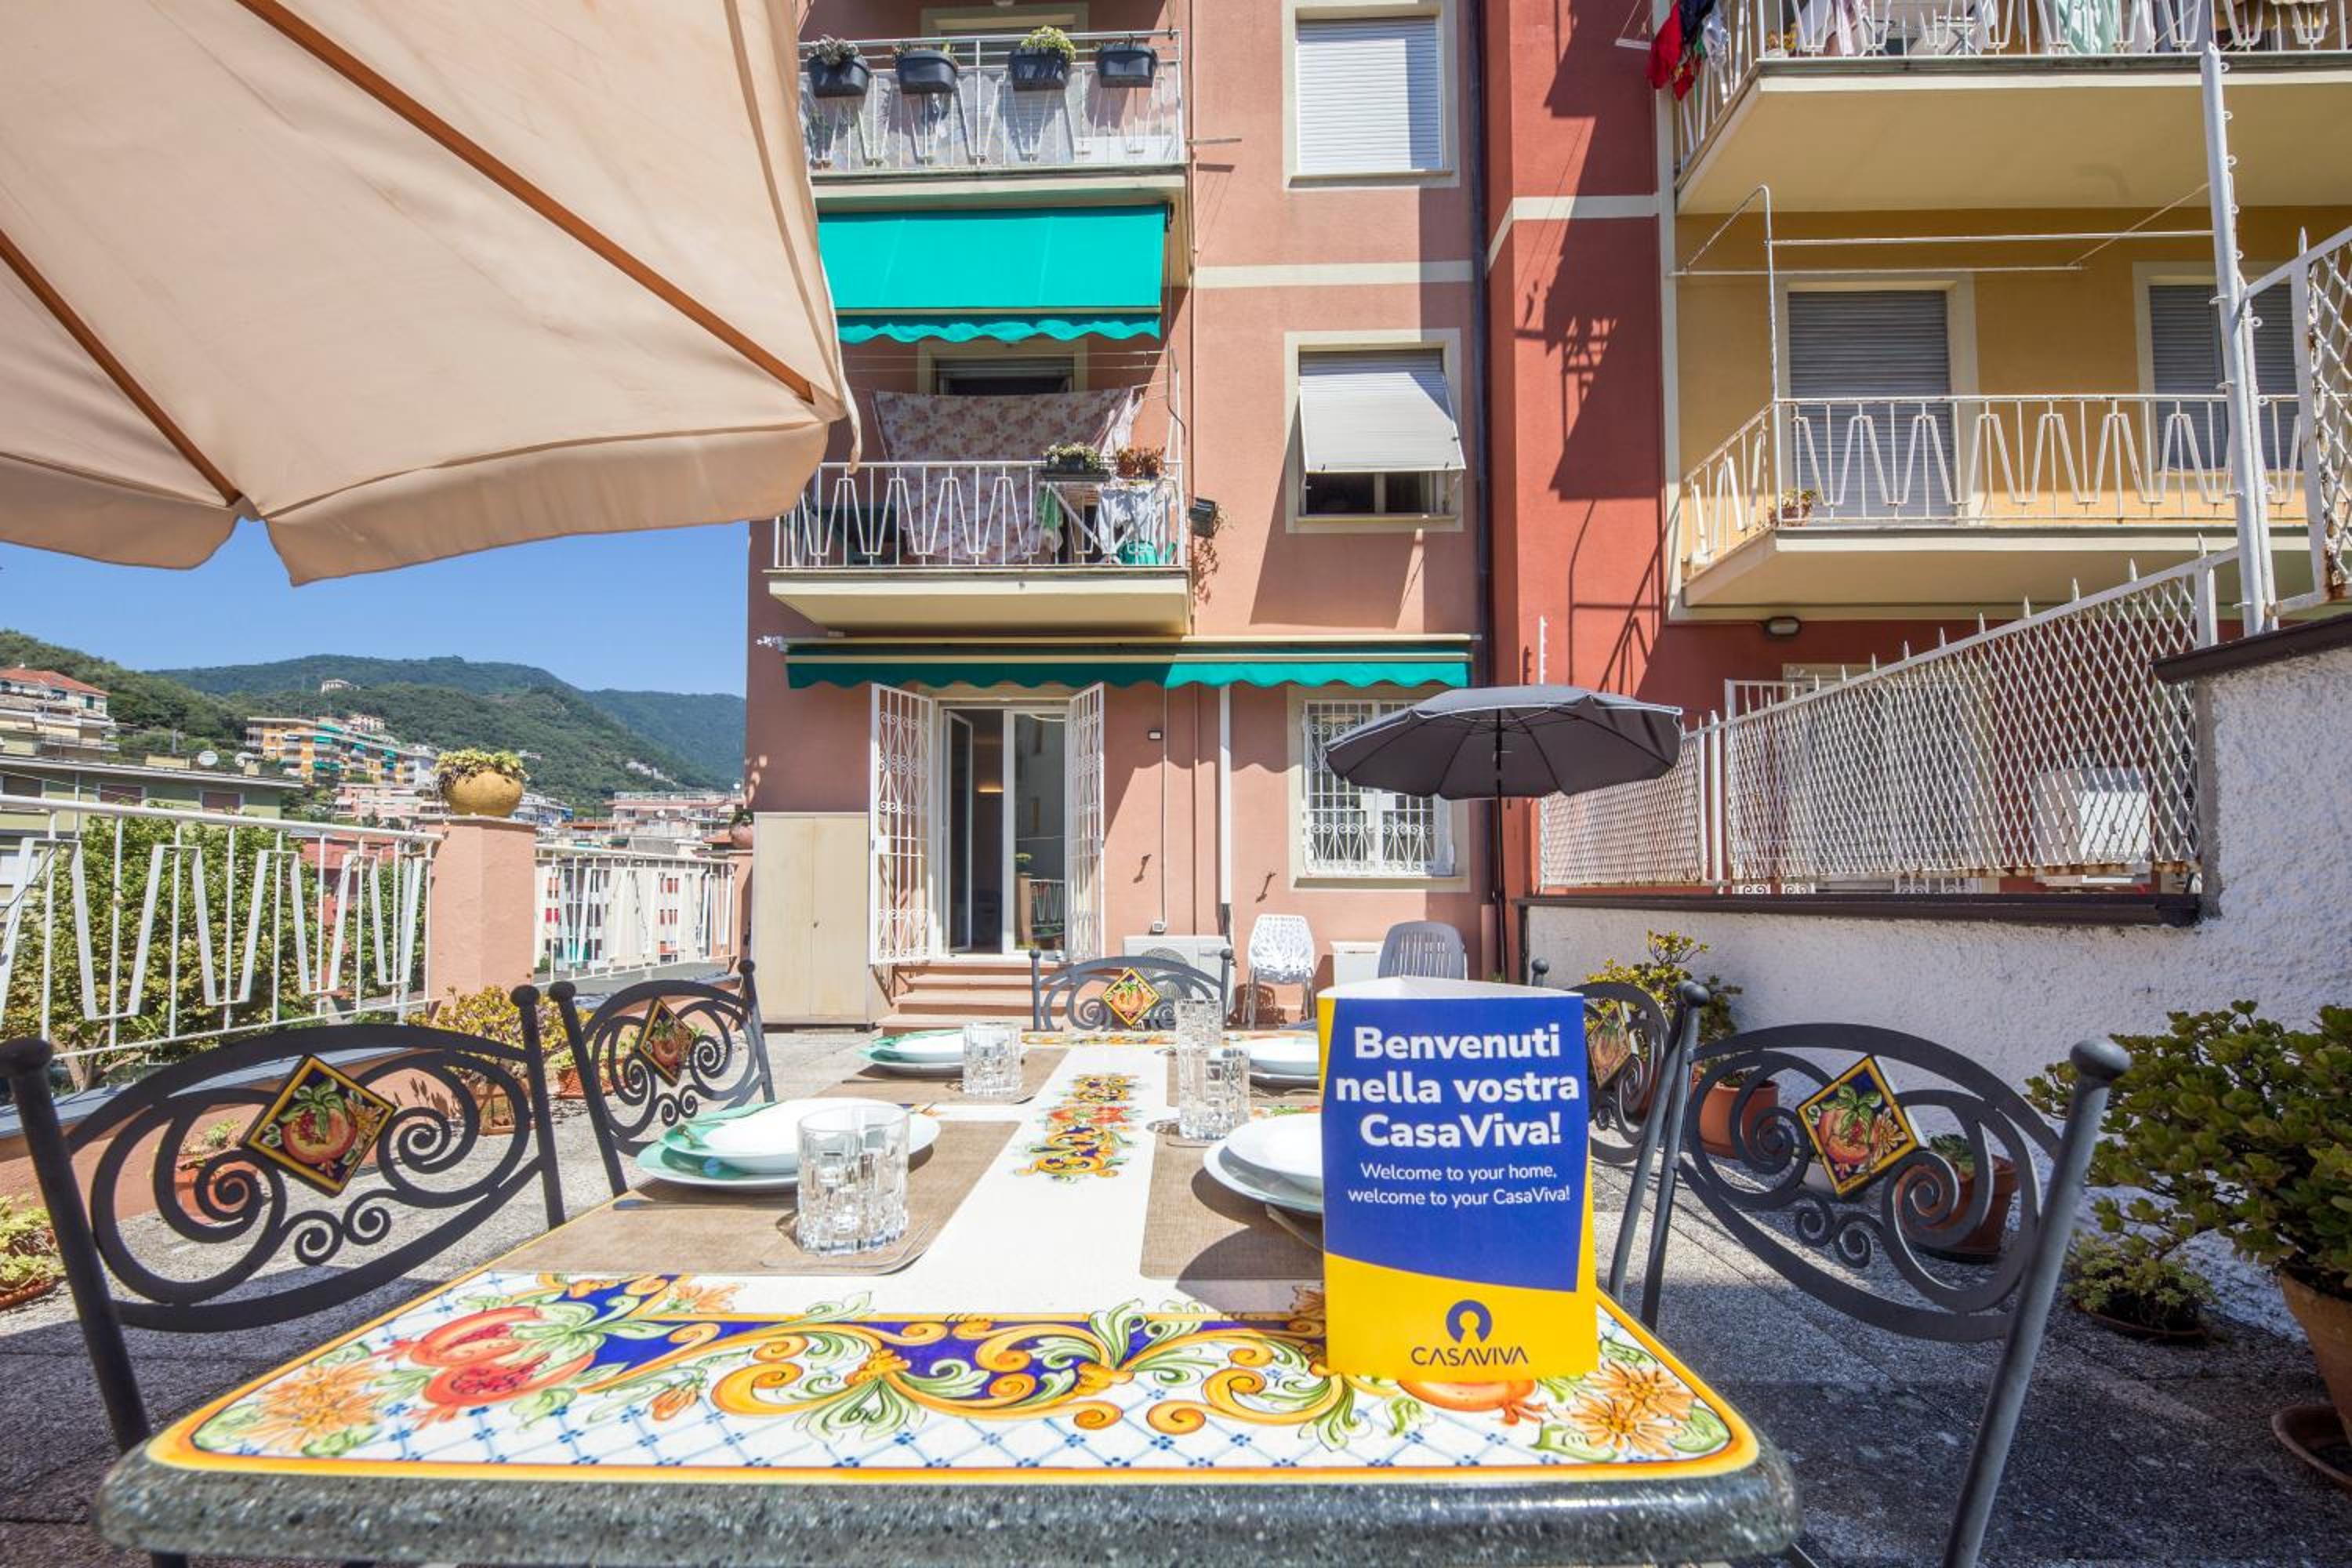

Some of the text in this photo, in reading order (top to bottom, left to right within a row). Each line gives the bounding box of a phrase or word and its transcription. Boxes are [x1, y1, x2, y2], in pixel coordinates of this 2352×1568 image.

[1355, 1023, 1561, 1059] Benvenuti
[1336, 1070, 1580, 1104] nella vostra
[1360, 1111, 1562, 1148] CasaViva!
[1360, 1163, 1442, 1181] Welcome
[1446, 1165, 1463, 1181] to
[1468, 1167, 1504, 1183] your
[1348, 1185, 1570, 1209] welcome to your CasaViva!
[1410, 1345, 1529, 1367] CASAVIVA
